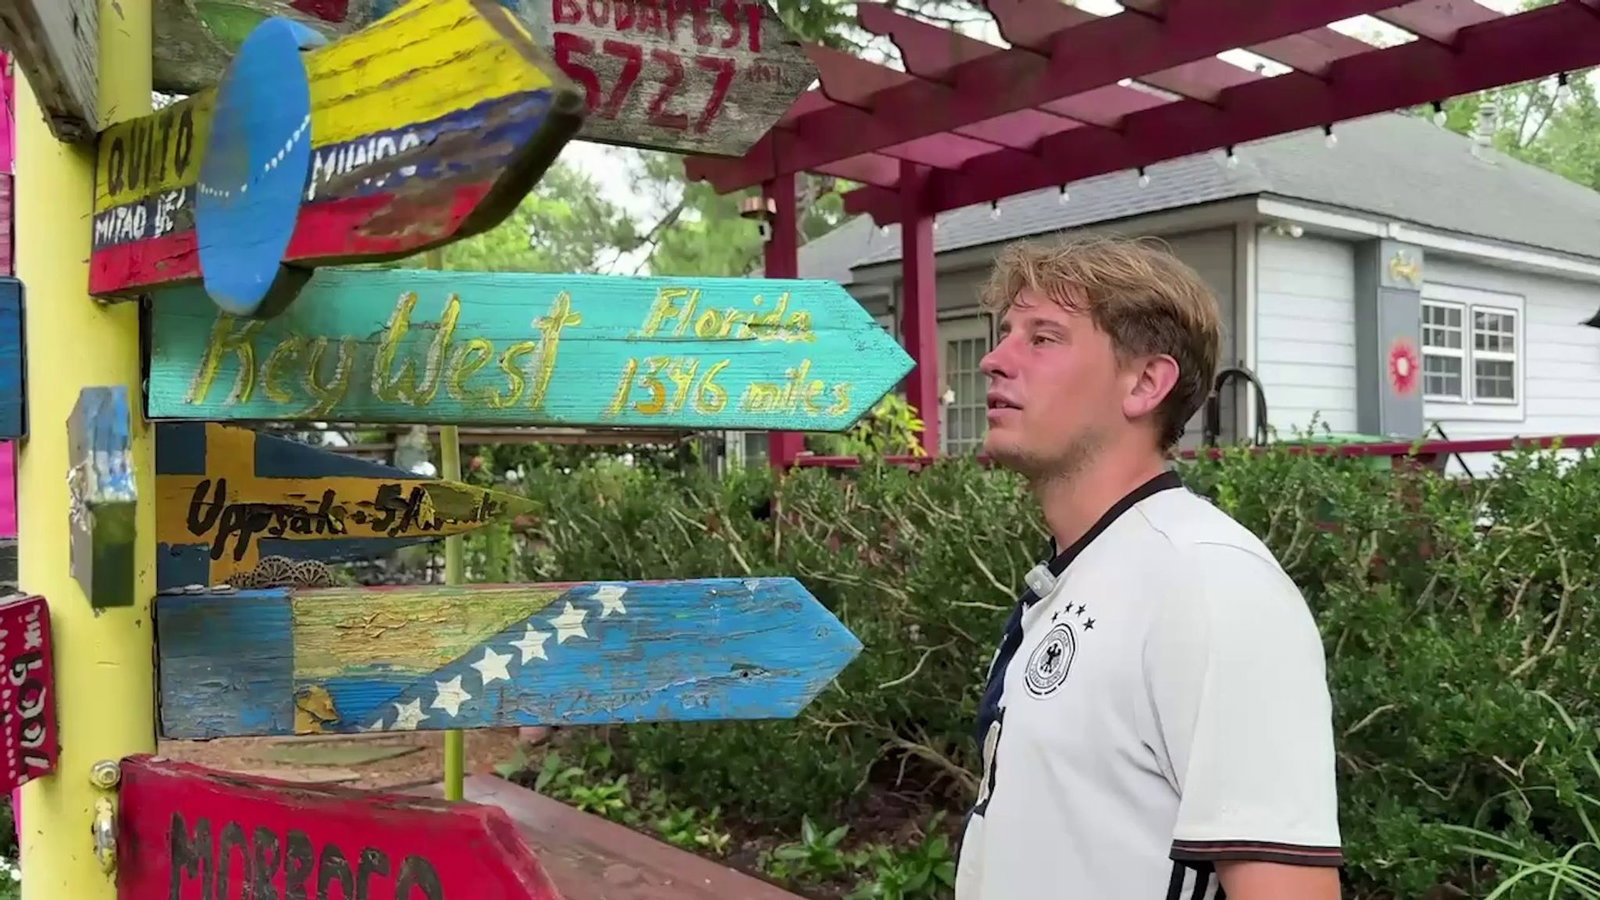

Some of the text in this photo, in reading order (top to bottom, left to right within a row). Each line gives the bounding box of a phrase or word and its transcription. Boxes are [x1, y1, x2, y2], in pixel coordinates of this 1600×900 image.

[553, 32, 737, 134] 5727
[108, 108, 195, 197] QUITO
[371, 291, 583, 410] West
[629, 288, 816, 342] Florida
[739, 359, 853, 416] miles
